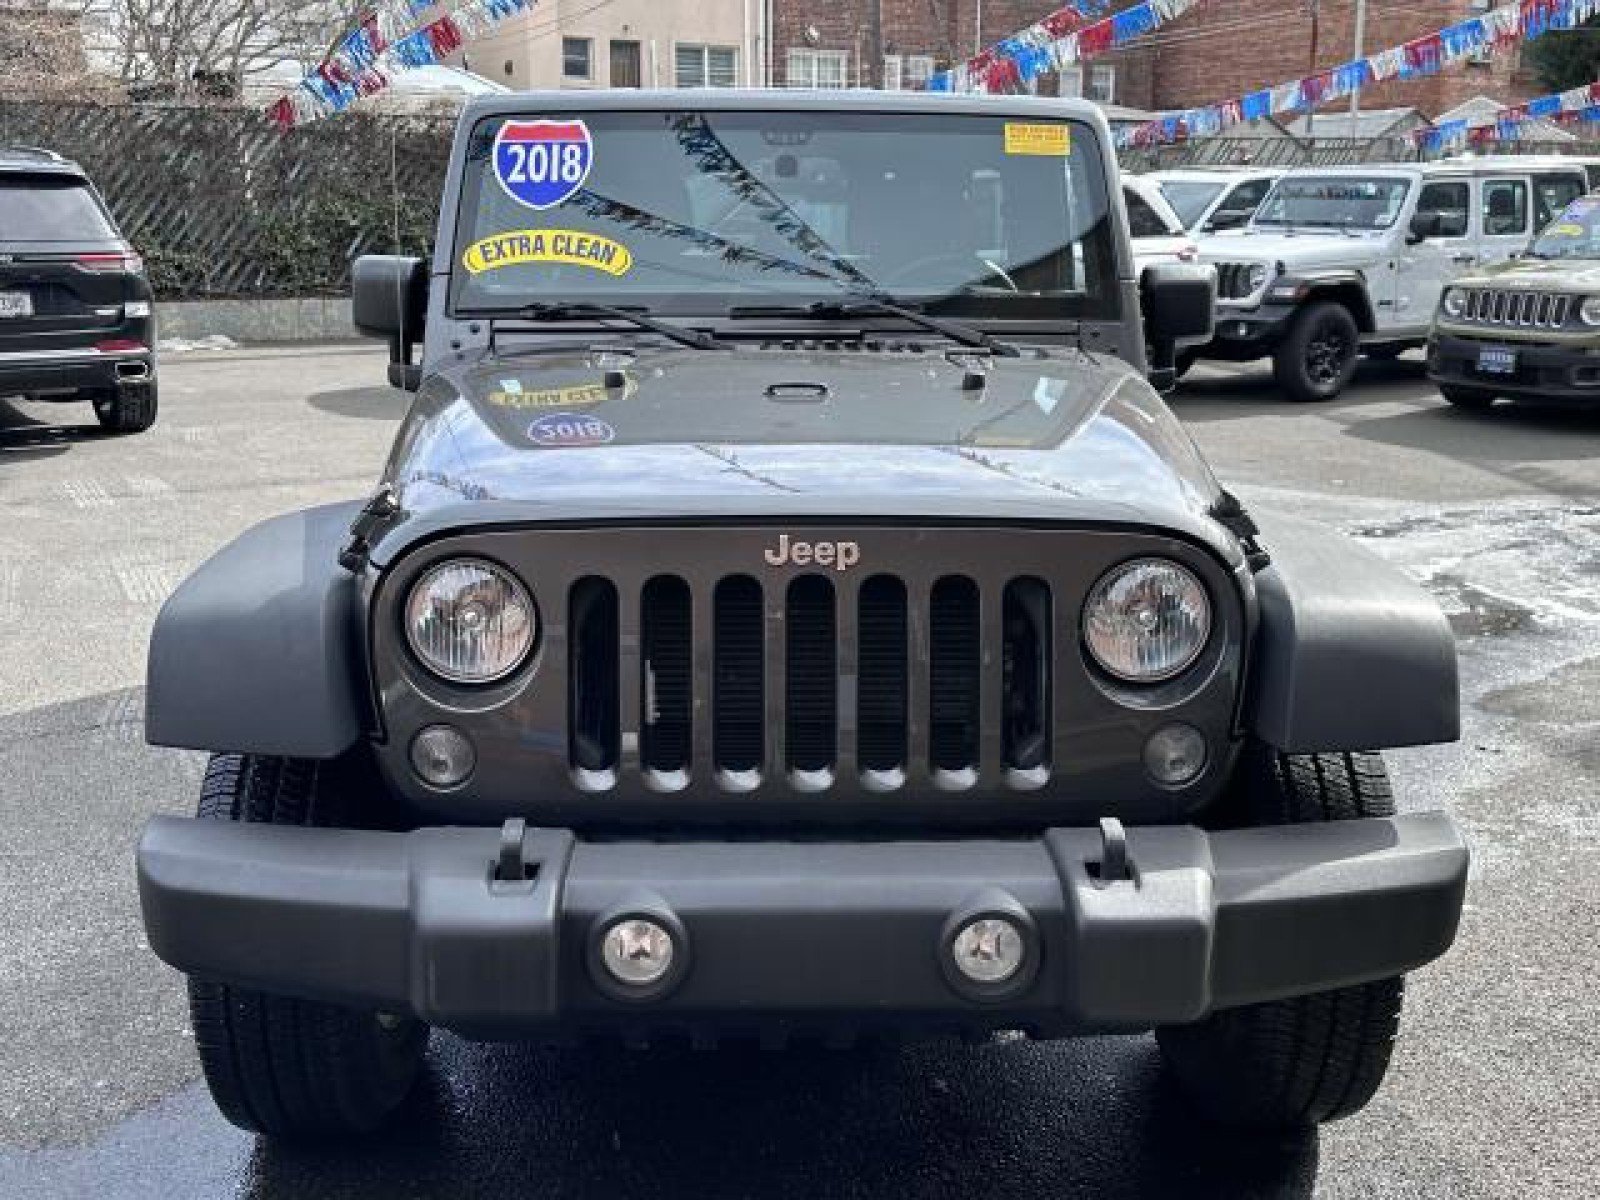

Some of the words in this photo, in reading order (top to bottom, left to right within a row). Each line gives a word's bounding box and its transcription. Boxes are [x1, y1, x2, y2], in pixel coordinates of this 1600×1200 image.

[507, 144, 581, 183] 2018
[480, 235, 544, 263] EXTRA
[552, 235, 618, 265] CLEAN
[764, 534, 860, 571] Jeep
